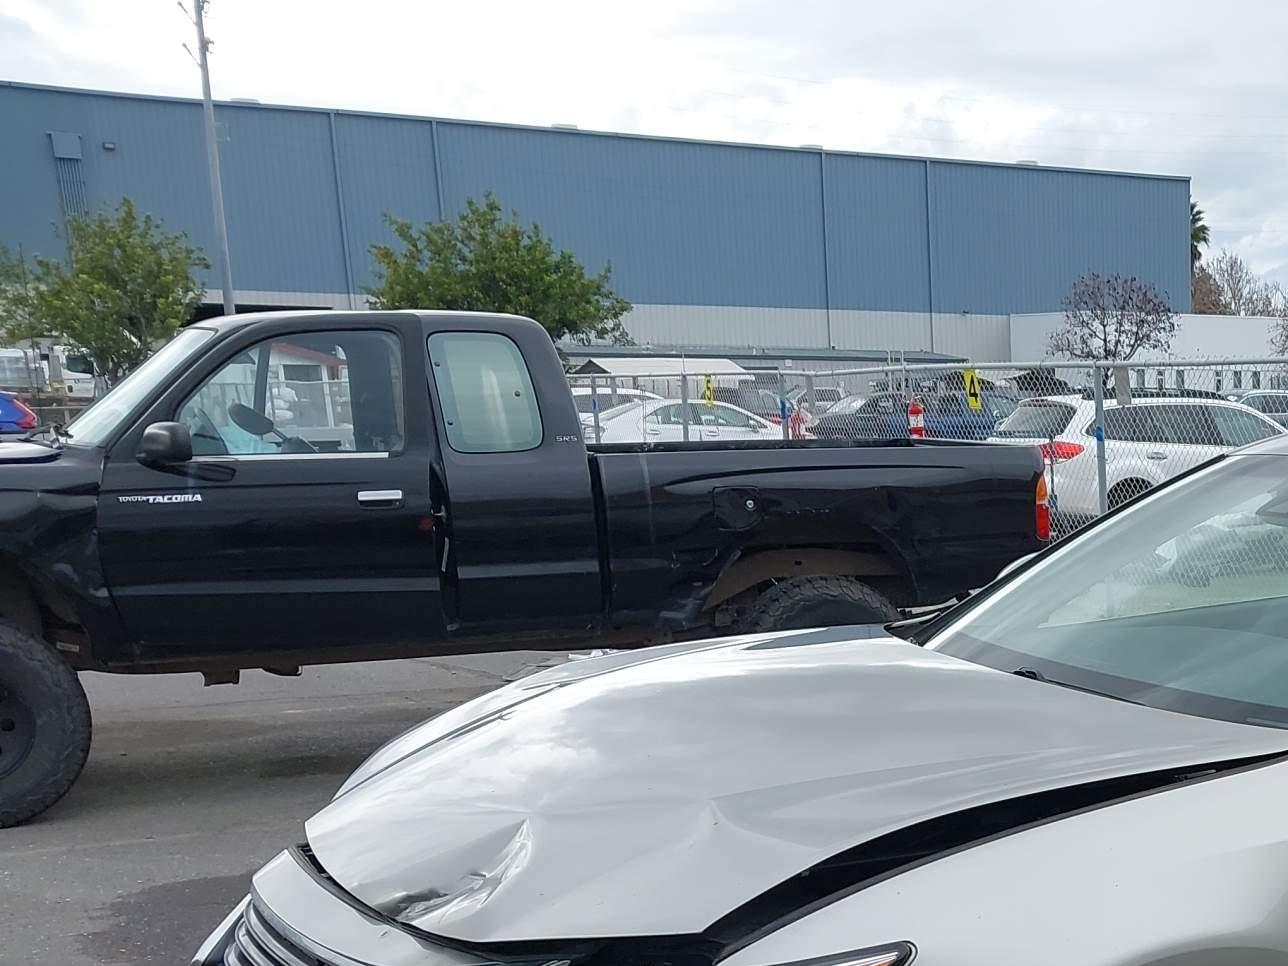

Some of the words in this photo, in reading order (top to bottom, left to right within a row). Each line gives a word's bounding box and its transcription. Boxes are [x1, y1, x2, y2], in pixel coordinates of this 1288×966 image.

[706, 379, 712, 400] 5
[969, 375, 978, 403] 4
[148, 494, 202, 504] TACOMA
